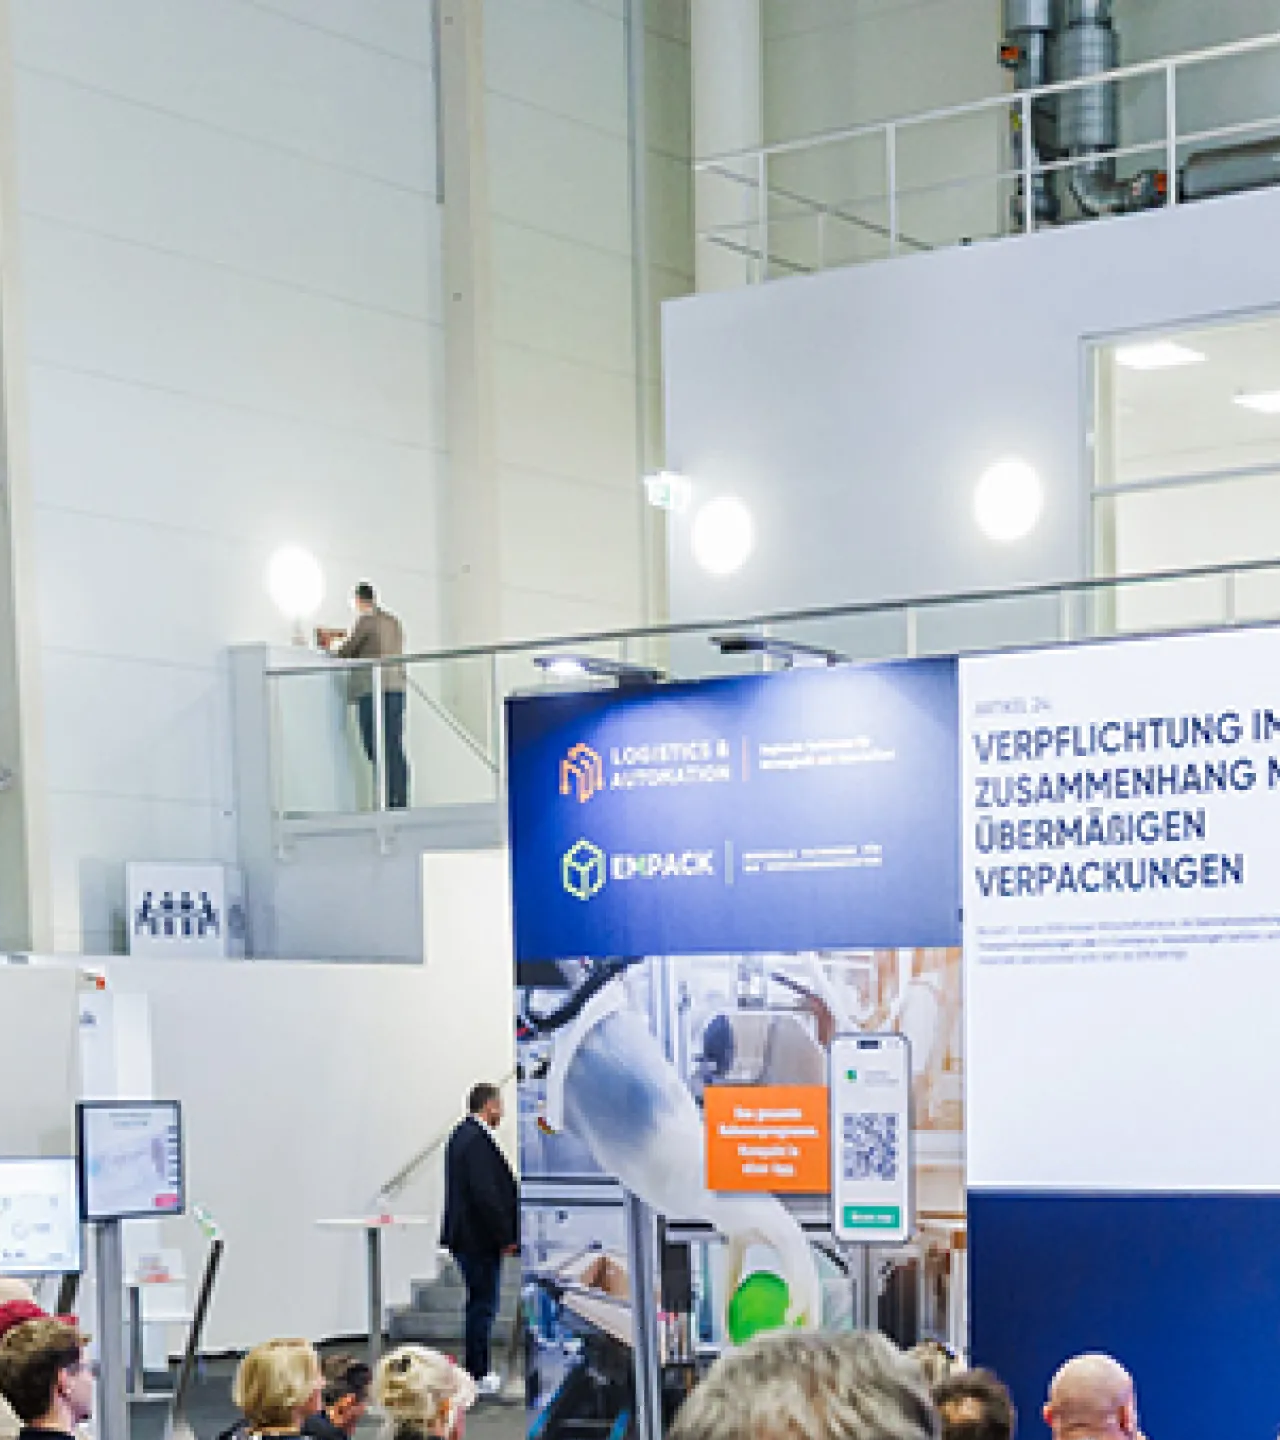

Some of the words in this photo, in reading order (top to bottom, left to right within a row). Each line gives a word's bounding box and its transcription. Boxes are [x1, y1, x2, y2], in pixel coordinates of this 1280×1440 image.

[609, 739, 710, 766] LOGISTICS
[973, 710, 1243, 763] VERPFLICHTUNG
[609, 764, 730, 790] AUTOMATION
[974, 758, 1257, 809] ZUSAMMENHANG
[974, 852, 1245, 897] VERPACKUNGEN
